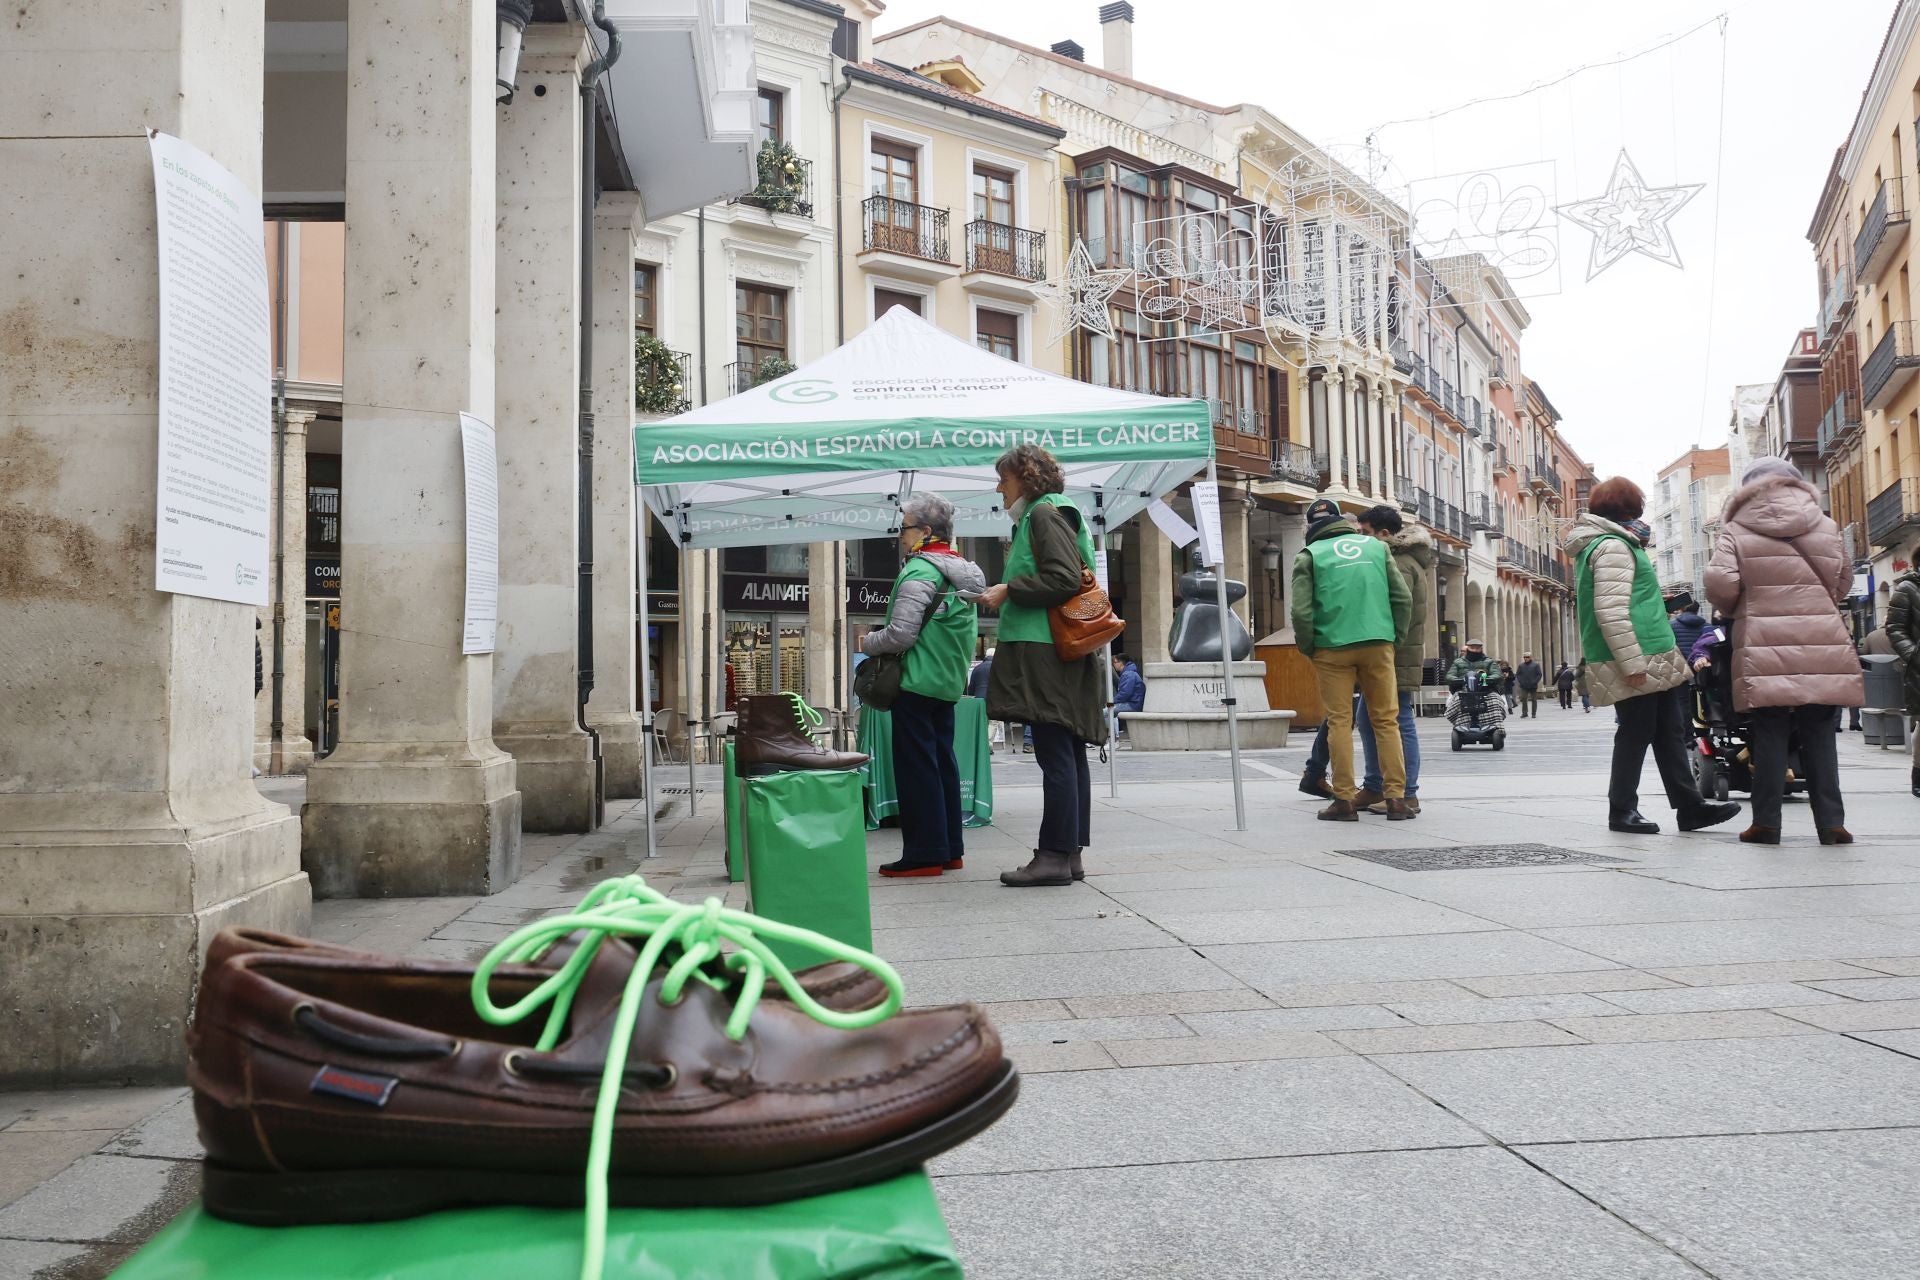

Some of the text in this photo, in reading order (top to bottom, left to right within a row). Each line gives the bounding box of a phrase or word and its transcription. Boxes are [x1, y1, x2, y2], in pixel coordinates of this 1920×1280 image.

[853, 375, 1046, 386] asociación española
[884, 392, 968, 400] Palencia
[652, 422, 1200, 464] ASOCIACIÓN ESPAÑOLA CONTRA EL CÁNCER
[315, 567, 340, 576] COM
[1192, 682, 1225, 697] MUJE
